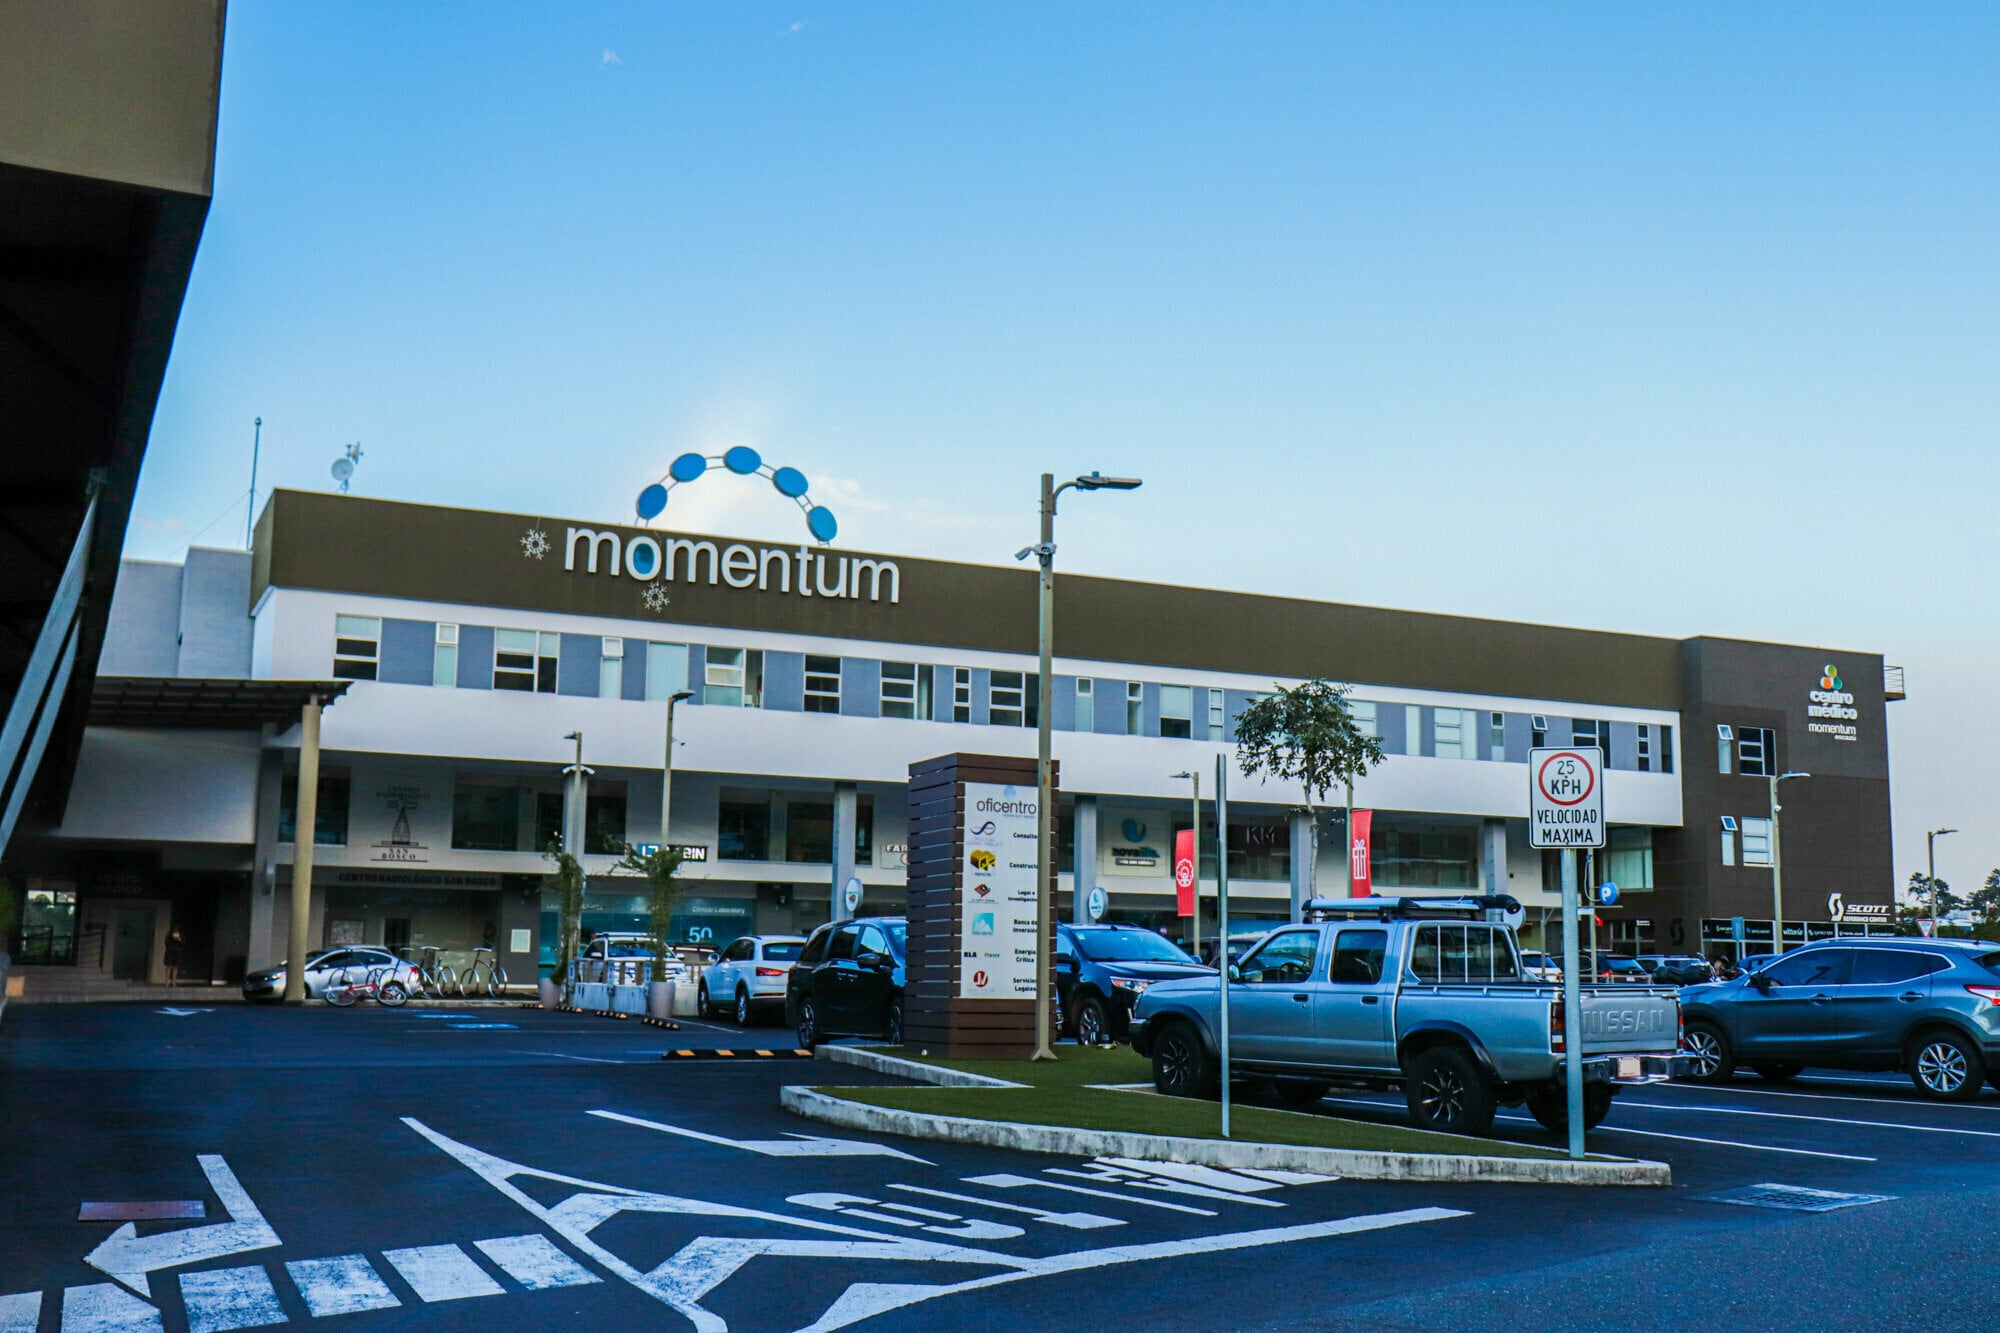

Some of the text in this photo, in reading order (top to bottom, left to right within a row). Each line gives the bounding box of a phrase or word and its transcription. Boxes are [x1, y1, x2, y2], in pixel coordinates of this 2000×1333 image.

[565, 527, 900, 603] momentum
[1809, 690, 1854, 705] centro
[1808, 702, 1858, 720] médico
[1808, 723, 1857, 735] momentum
[1557, 760, 1575, 775] 25
[1551, 779, 1581, 795] KPH
[976, 797, 1037, 815] oficentro
[1537, 809, 1597, 824] VELOCIDAD
[1542, 828, 1594, 843] MAXIMA
[338, 873, 377, 882] CENTRO
[444, 876, 463, 885] SAN
[465, 876, 496, 886] BOSCO
[714, 906, 745, 914] Laboratory
[1846, 904, 1889, 913] SCOTT
[1582, 1009, 1664, 1034] NISSAN
